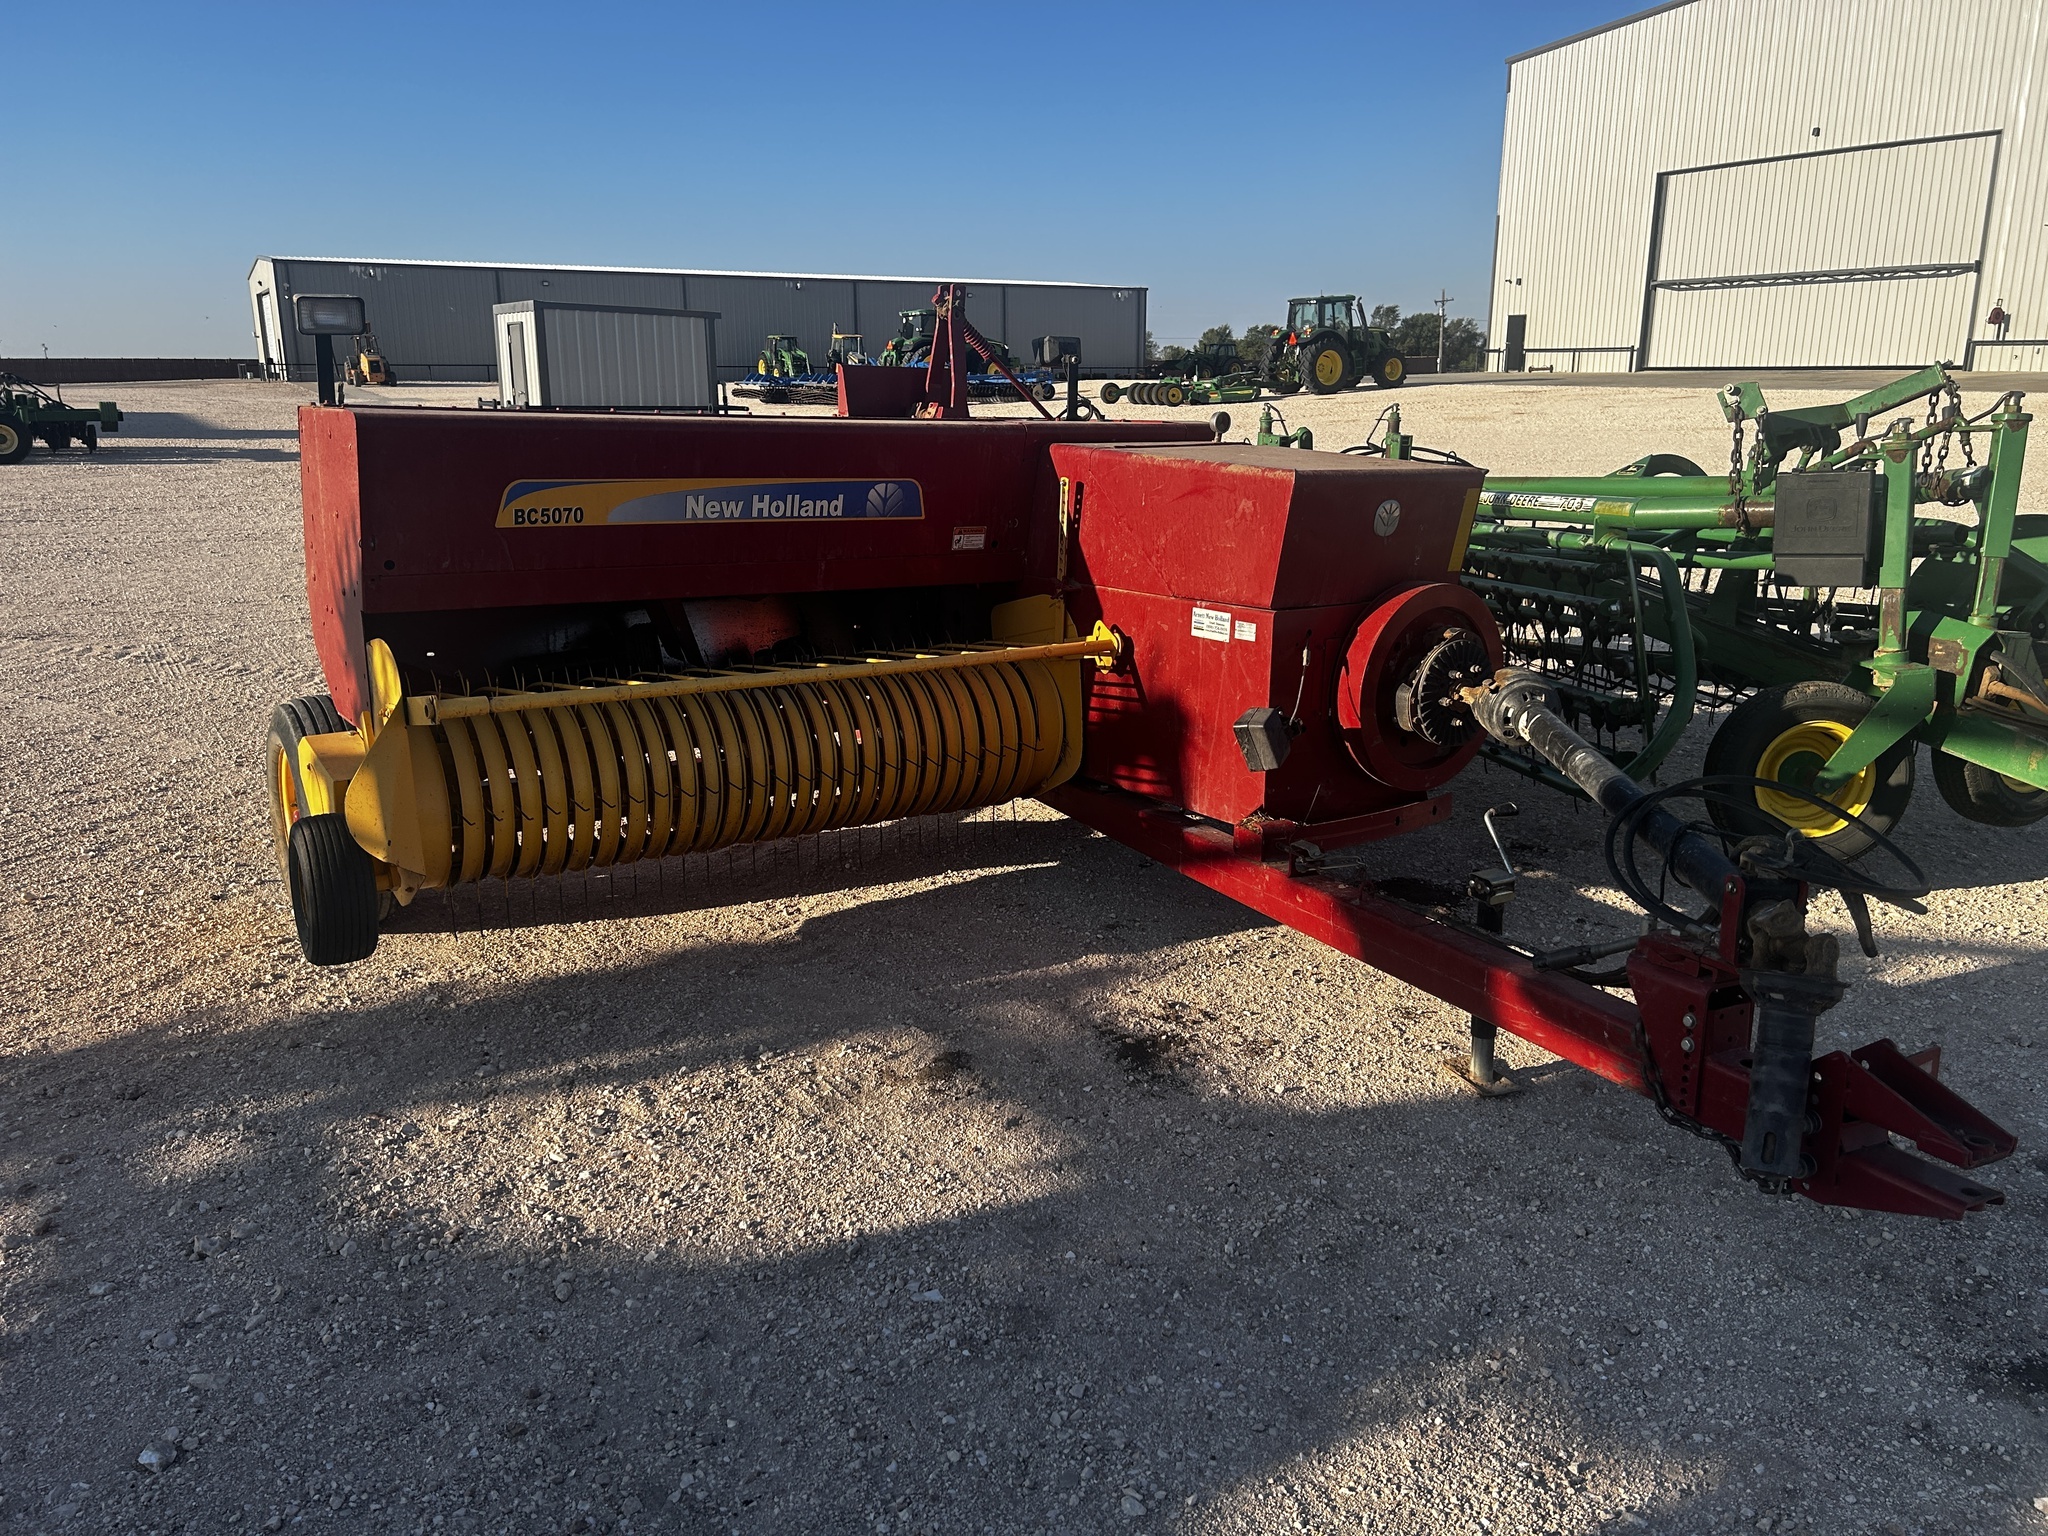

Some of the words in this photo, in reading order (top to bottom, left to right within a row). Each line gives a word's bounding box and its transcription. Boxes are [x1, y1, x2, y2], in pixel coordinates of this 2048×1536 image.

[685, 495, 743, 519] New
[751, 494, 844, 518] Holland
[1510, 494, 1541, 507] DEERE
[513, 506, 585, 526] BC5070
